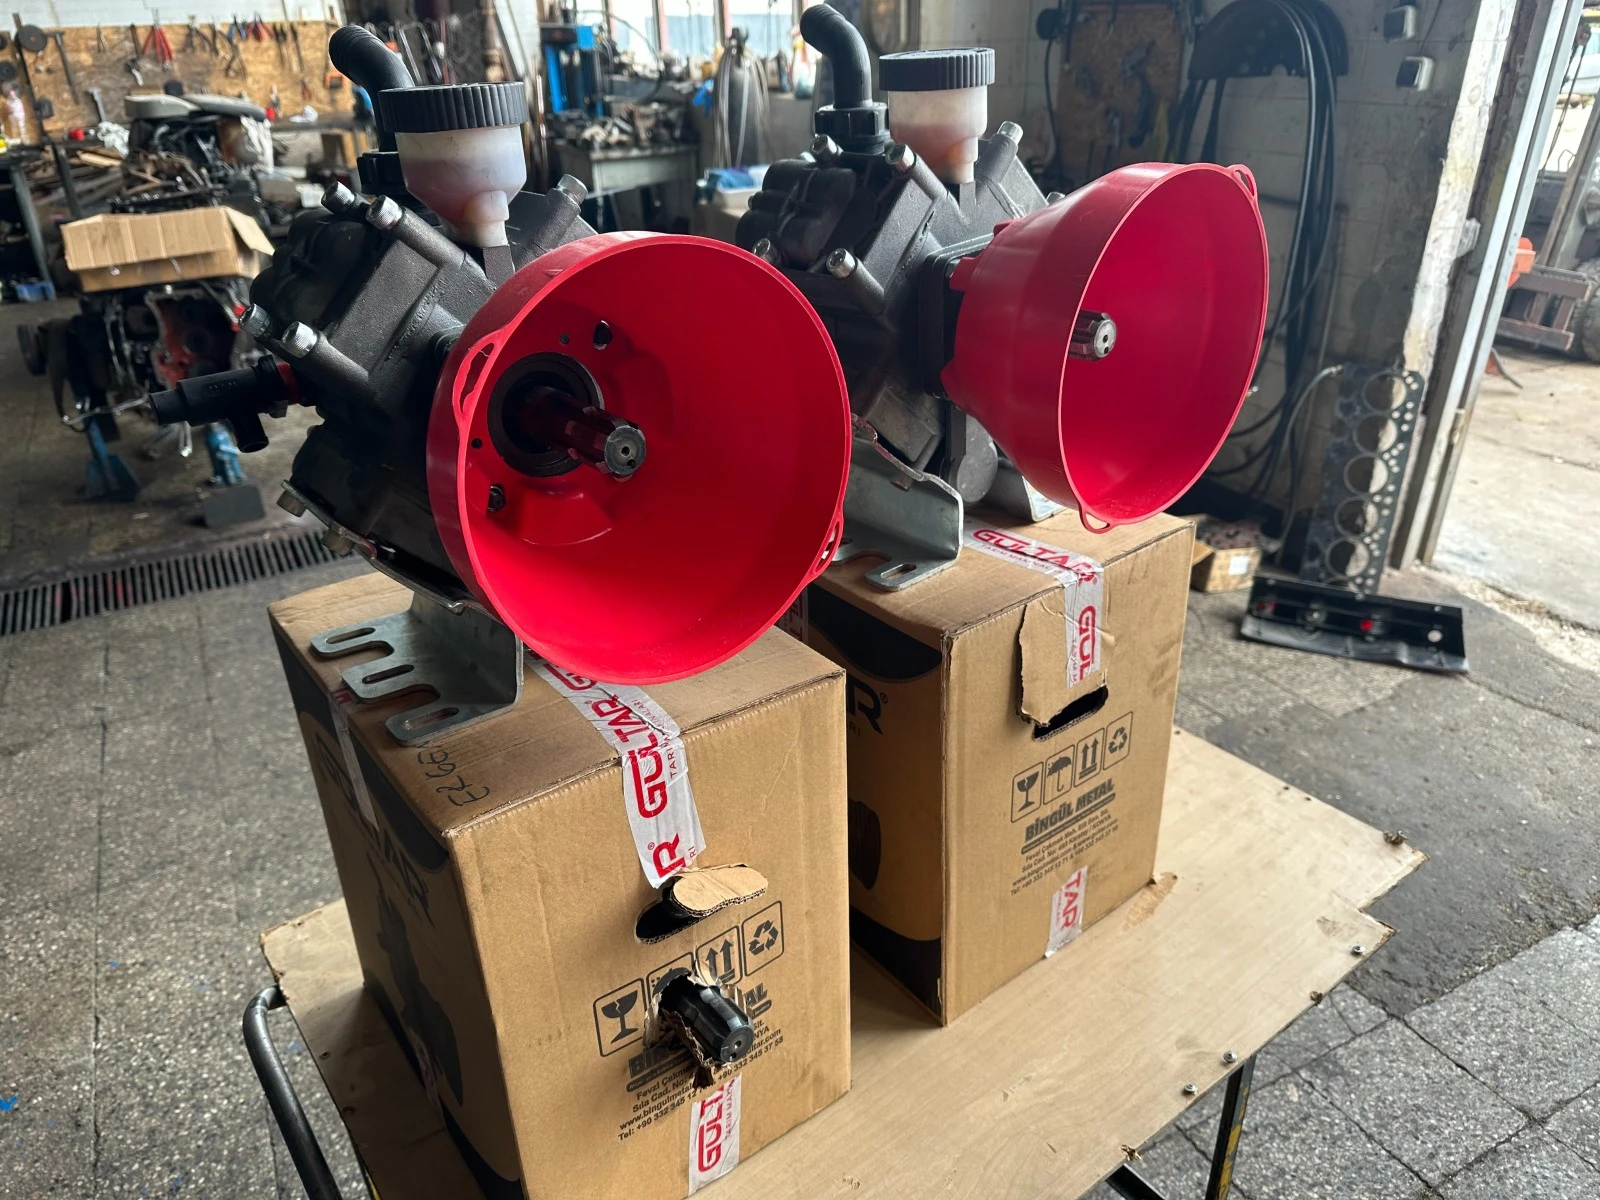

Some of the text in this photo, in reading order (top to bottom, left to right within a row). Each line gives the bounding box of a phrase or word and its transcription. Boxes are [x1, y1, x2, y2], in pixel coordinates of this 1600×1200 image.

[846, 672, 884, 736] R
[591, 693, 667, 819] GULTAR
[1075, 778, 1115, 813] METAL
[617, 1128, 635, 1141] Tel:
[636, 1117, 652, 1130] +90
[653, 1106, 669, 1121] 332
[670, 1097, 686, 1111] 345
[687, 1090, 697, 1101] 12
[733, 1058, 748, 1072] 332
[748, 1051, 763, 1063] 345
[763, 1042, 774, 1053] 37
[619, 1082, 693, 1131] www.bingulmetal
[636, 1081, 660, 1101] Fevzi
[651, 1087, 671, 1102] Cad.
[672, 1078, 688, 1090] No:
[697, 1084, 725, 1173] GULT
